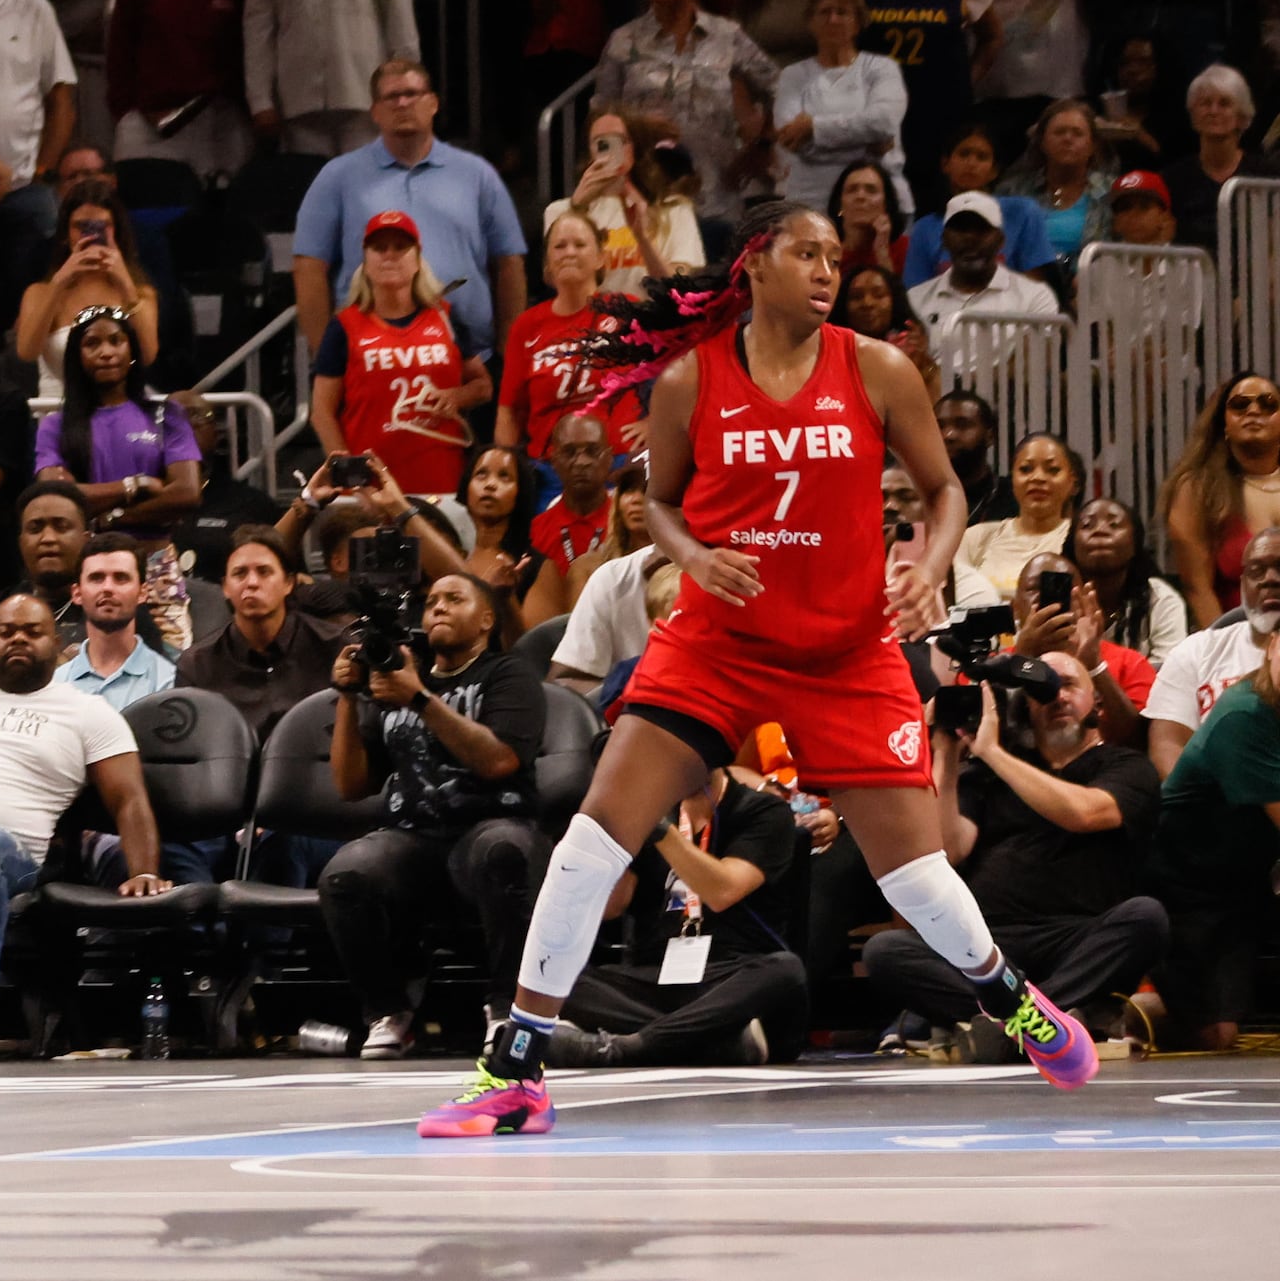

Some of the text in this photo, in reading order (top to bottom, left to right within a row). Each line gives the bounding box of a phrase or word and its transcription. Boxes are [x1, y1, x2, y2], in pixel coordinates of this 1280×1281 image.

[870, 7, 948, 25] NDIANA
[363, 343, 450, 373] FEVER
[722, 424, 855, 466] FEVER
[774, 470, 801, 522] 7
[730, 527, 823, 551] salesforce
